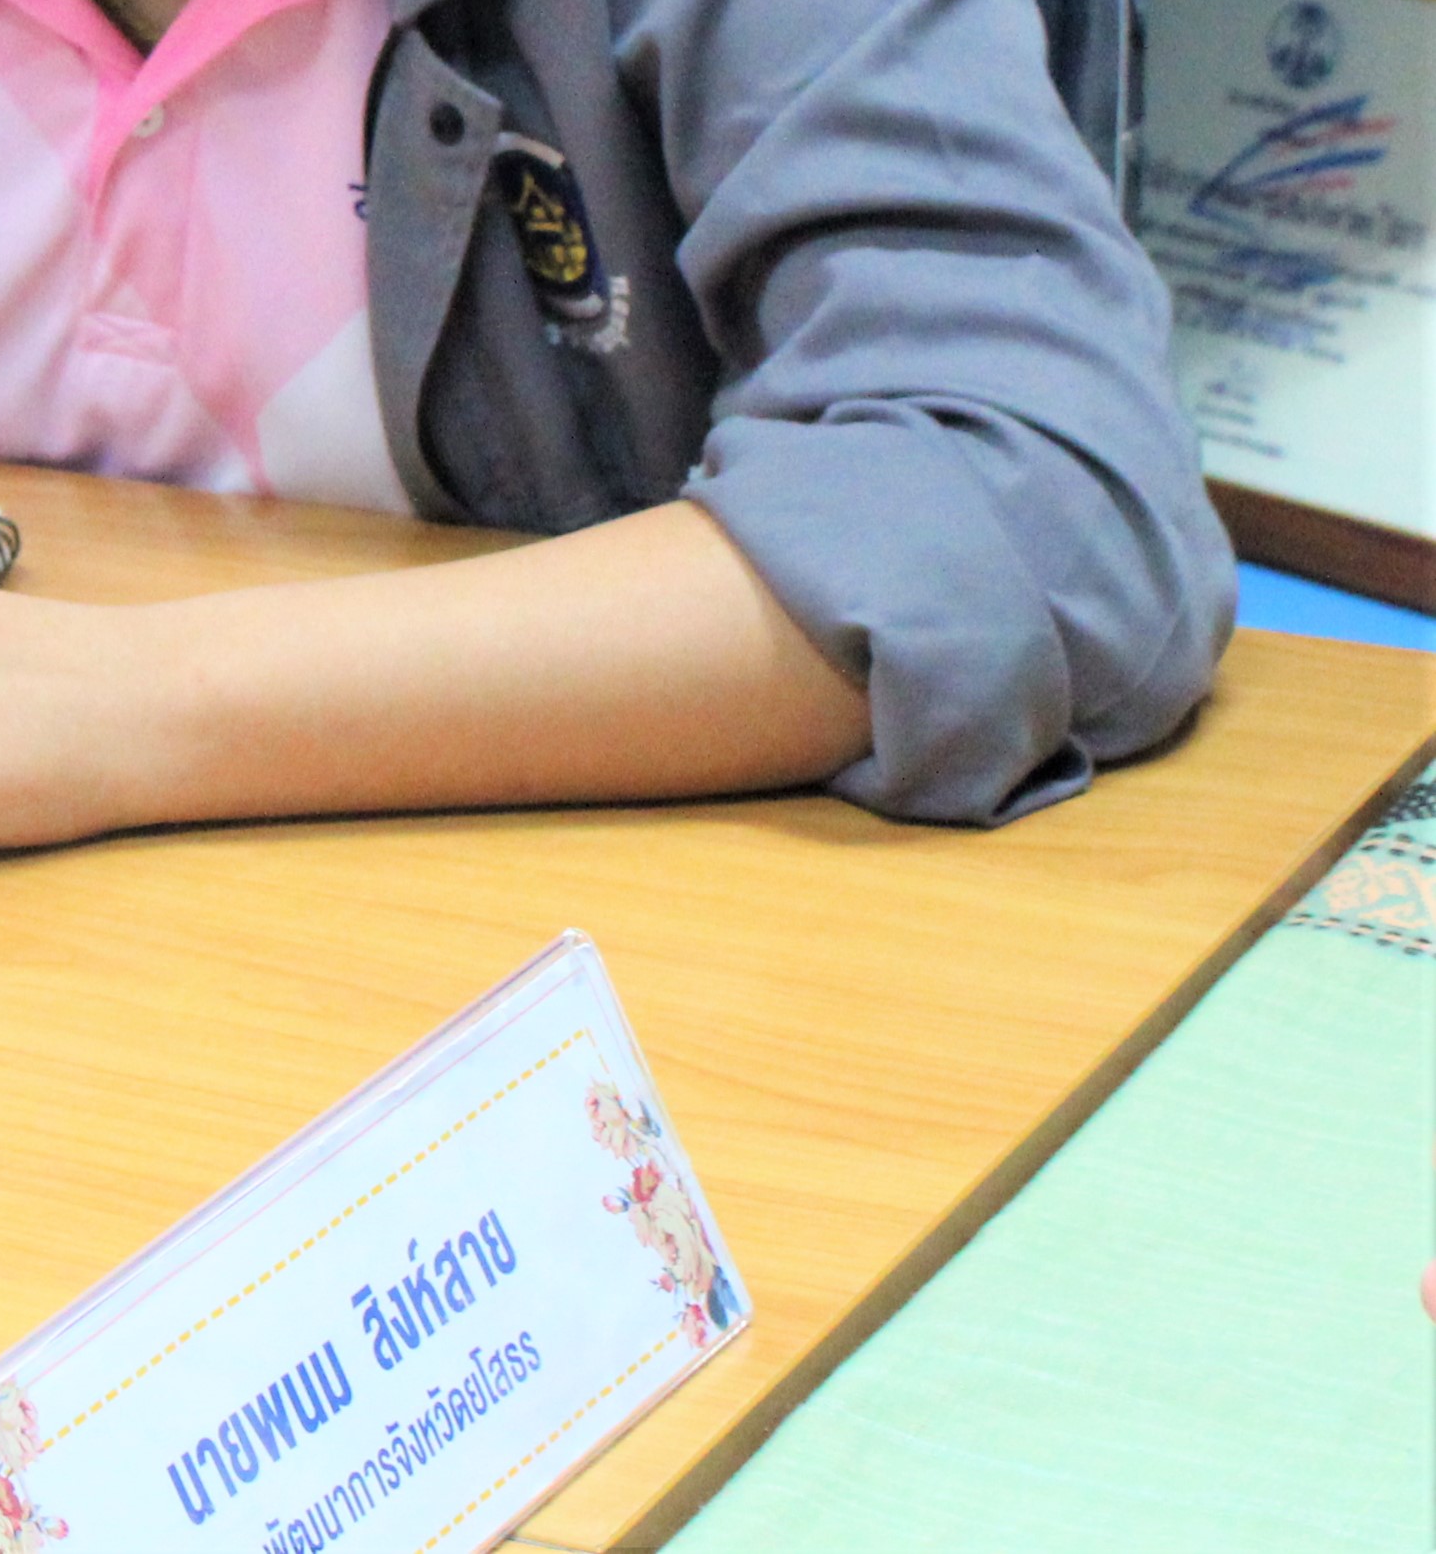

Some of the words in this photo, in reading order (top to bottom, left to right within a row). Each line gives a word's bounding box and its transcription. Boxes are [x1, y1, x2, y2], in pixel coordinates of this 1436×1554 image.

[167, 1340, 353, 1526] นายพนม
[351, 1209, 517, 1371] สิงห์สาย
